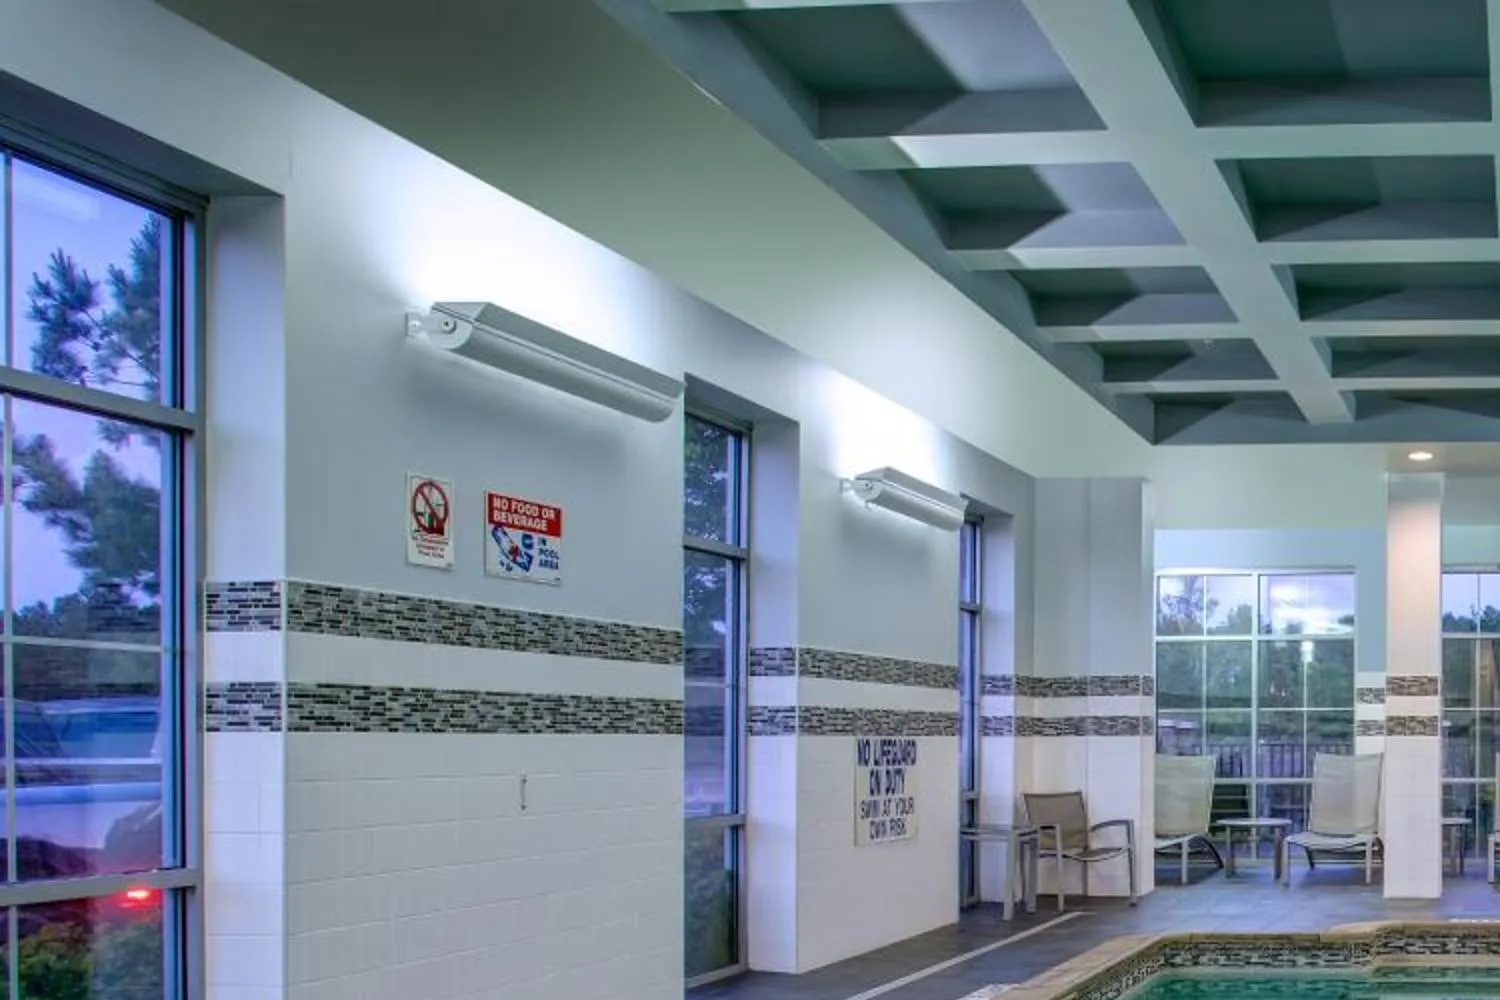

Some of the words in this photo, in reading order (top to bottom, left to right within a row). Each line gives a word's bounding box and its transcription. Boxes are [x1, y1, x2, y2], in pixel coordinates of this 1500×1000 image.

[493, 496, 509, 511] NO
[512, 501, 539, 517] FOOD
[541, 508, 555, 519] OR
[493, 509, 548, 531] BEVERAGE
[858, 739, 871, 767] NO
